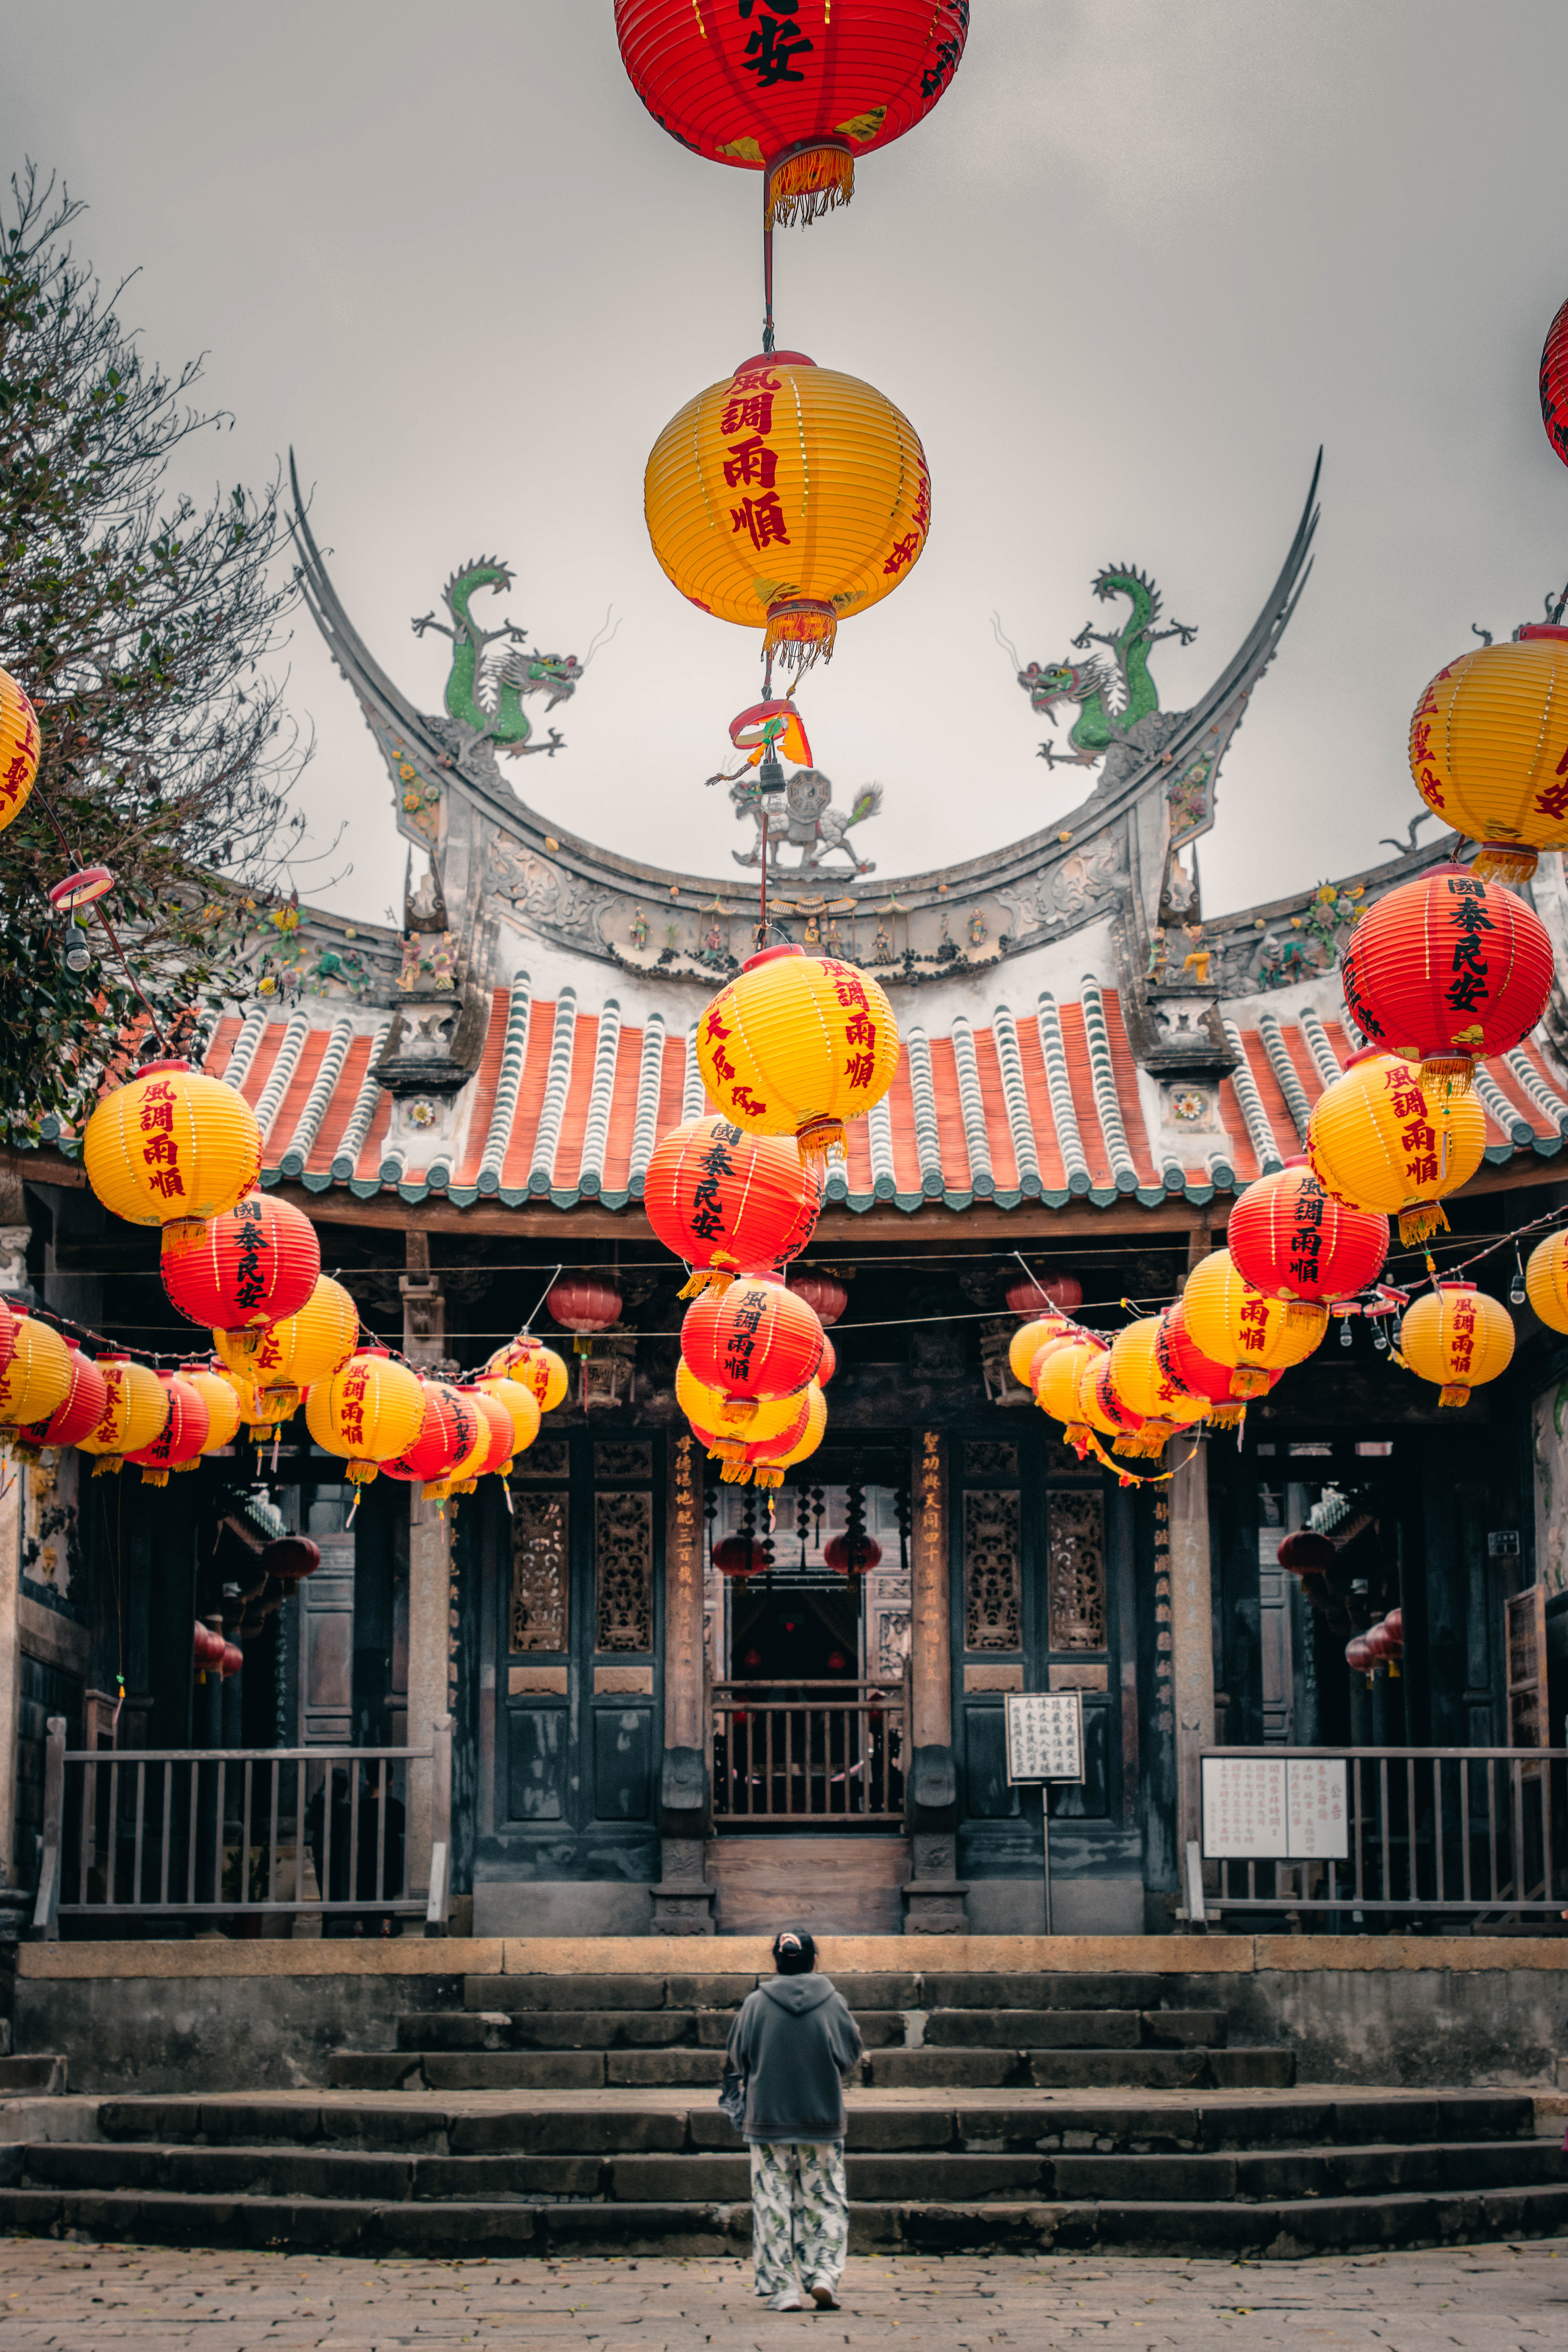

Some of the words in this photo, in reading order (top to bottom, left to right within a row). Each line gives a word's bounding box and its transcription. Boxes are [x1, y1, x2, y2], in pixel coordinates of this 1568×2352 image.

[738, 0, 814, 87] 安
[720, 368, 791, 551] 風調雨順
[1444, 878, 1497, 1013] 國泰民安
[816, 960, 876, 1089] 風調雨順
[138, 1080, 186, 1199] 風調雨順
[1383, 1064, 1438, 1186] 風調雨順
[690, 1123, 744, 1242] 國泰民安
[1289, 1177, 1329, 1284] 風調雨順
[232, 1200, 270, 1309] 國泰民安
[724, 1291, 768, 1382] 風調雨順
[1238, 1284, 1270, 1352] 雨順
[1450, 1298, 1477, 1373] 風調雨順
[341, 1364, 370, 1445] 風調雨順
[439, 1389, 471, 1462] 天上聖母
